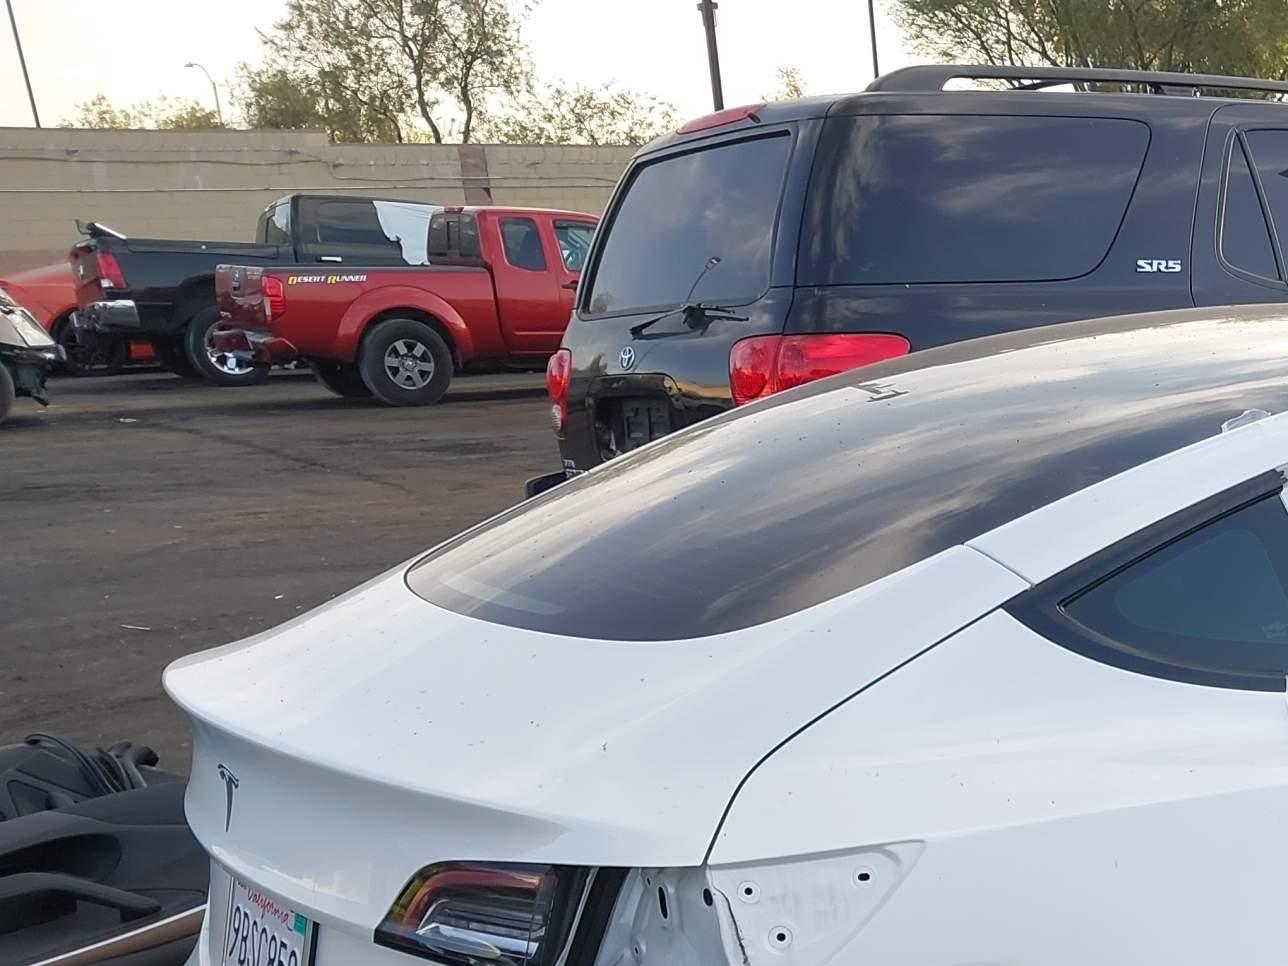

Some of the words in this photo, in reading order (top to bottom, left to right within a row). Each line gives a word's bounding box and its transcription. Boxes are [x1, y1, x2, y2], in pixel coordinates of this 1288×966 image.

[1136, 259, 1181, 273] SR5
[287, 275, 325, 285] DESERT
[327, 274, 368, 284] RUNNER
